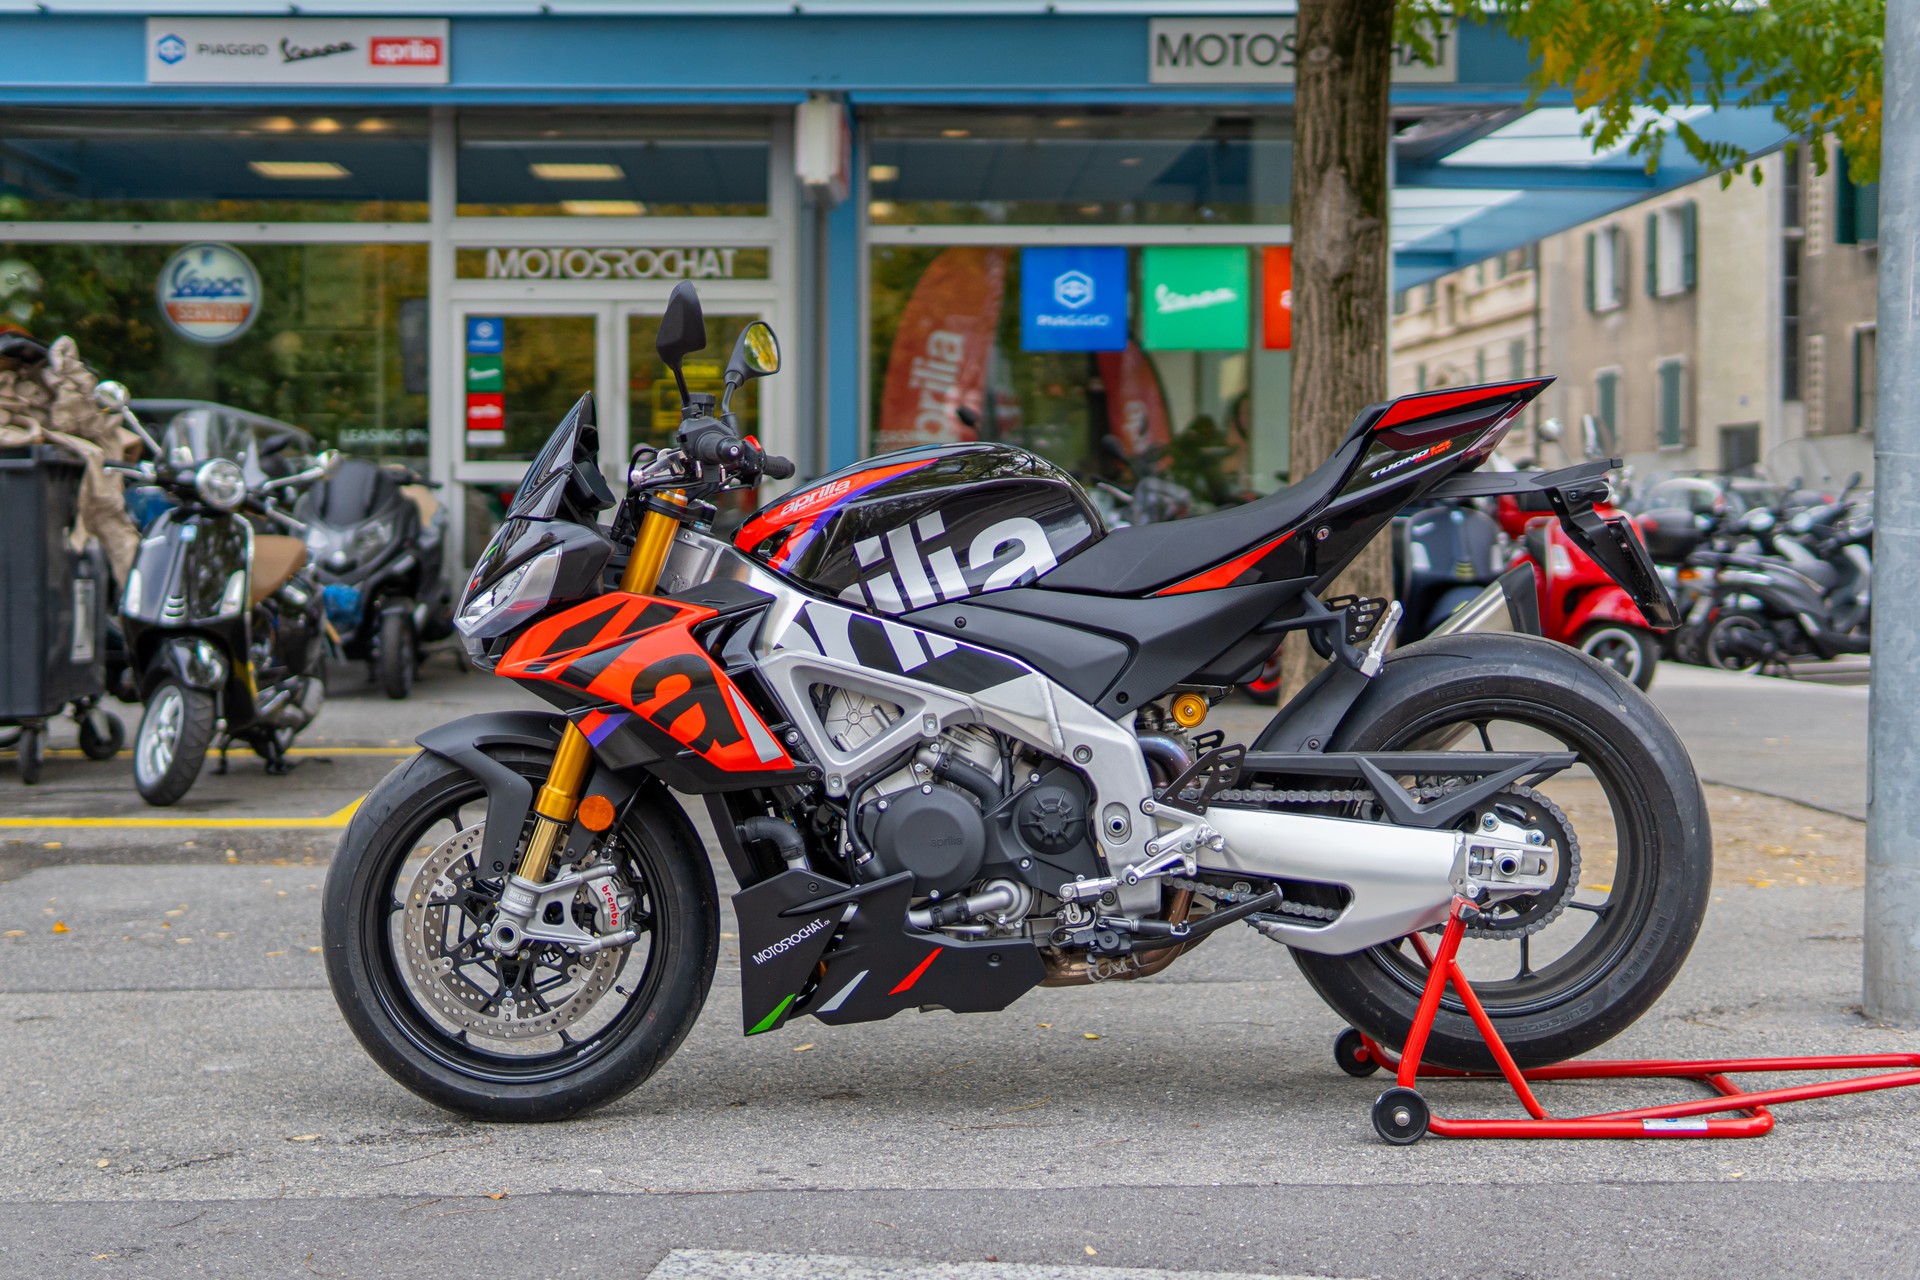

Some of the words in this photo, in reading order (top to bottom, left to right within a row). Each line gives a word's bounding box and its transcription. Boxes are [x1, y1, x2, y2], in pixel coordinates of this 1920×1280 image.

[197, 43, 269, 56] PIAGGIO
[279, 37, 358, 63] Vespa
[376, 40, 436, 62] aprilia
[486, 249, 736, 278] MOTOSROCHAT
[911, 329, 964, 442] prilia
[1369, 448, 1430, 478] TUONO
[780, 480, 851, 516] aprilia
[601, 884, 618, 926] brembo
